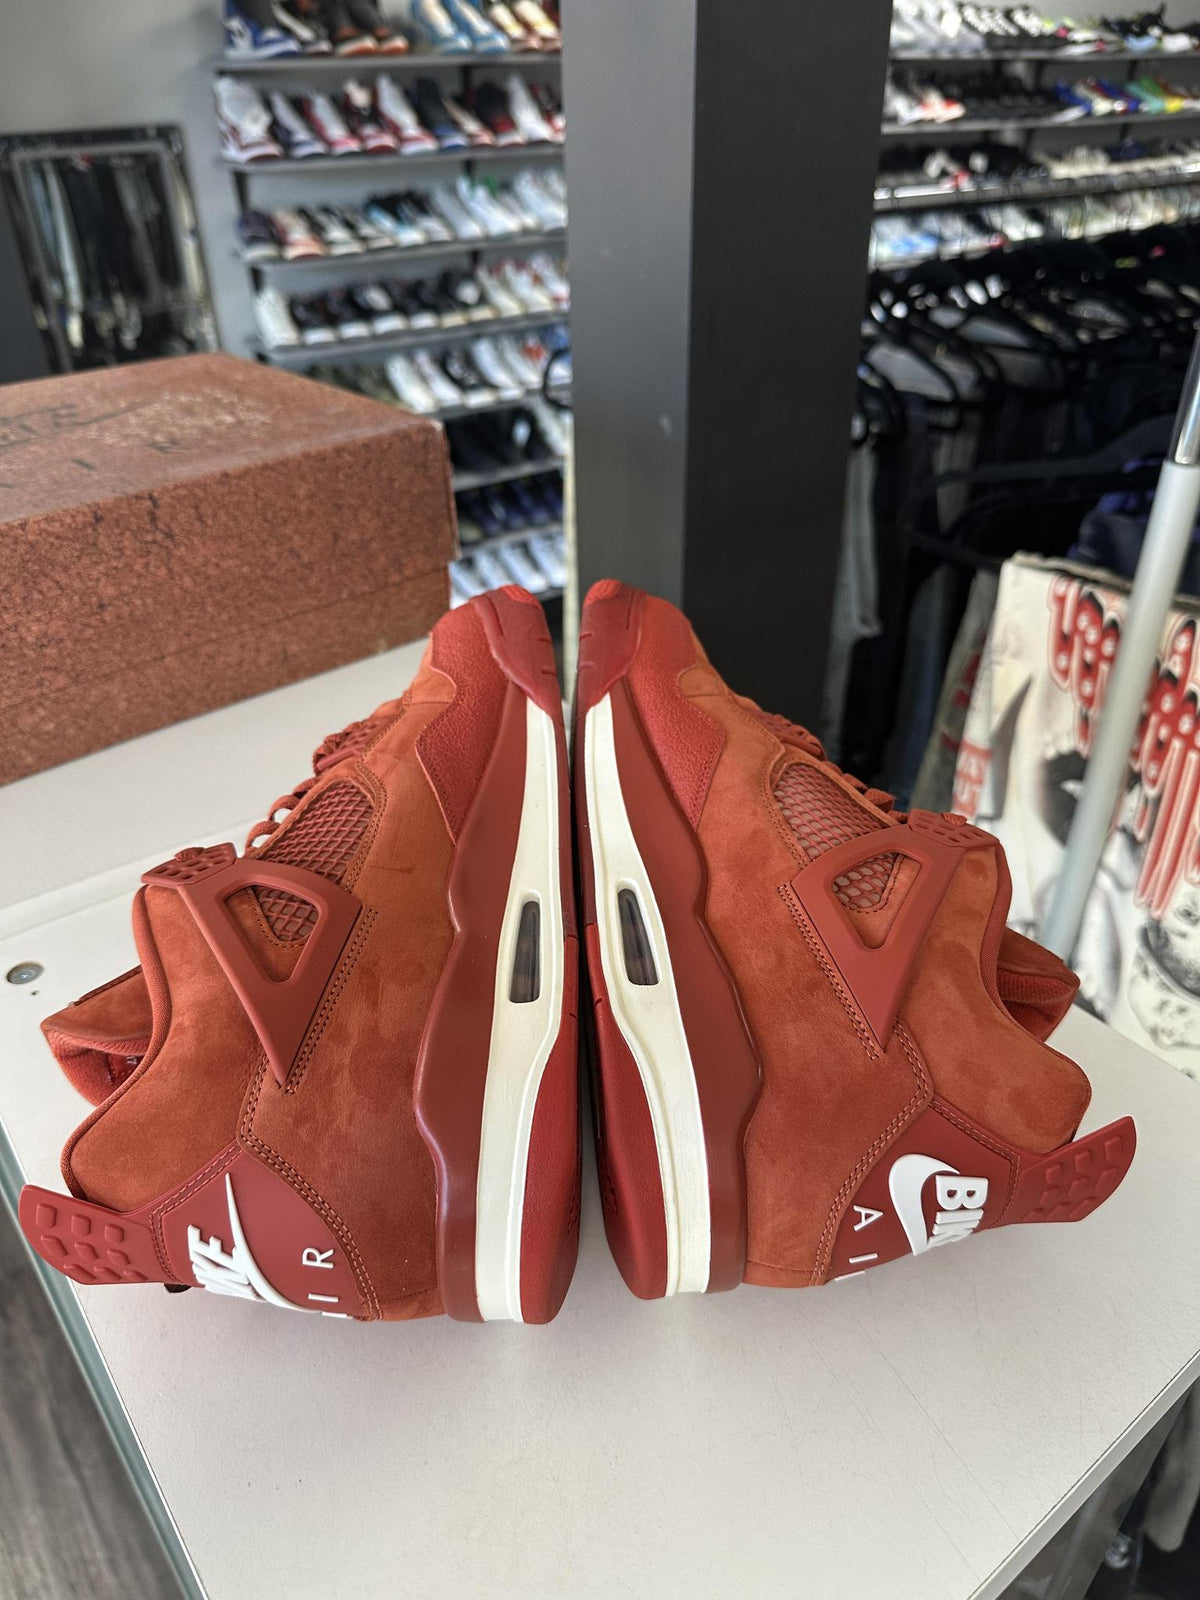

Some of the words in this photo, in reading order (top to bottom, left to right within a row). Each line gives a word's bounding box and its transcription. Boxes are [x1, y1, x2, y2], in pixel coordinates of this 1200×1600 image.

[834, 1204, 884, 1281] AI
[927, 1174, 989, 1247] BIK
[302, 1247, 350, 1319] IR
